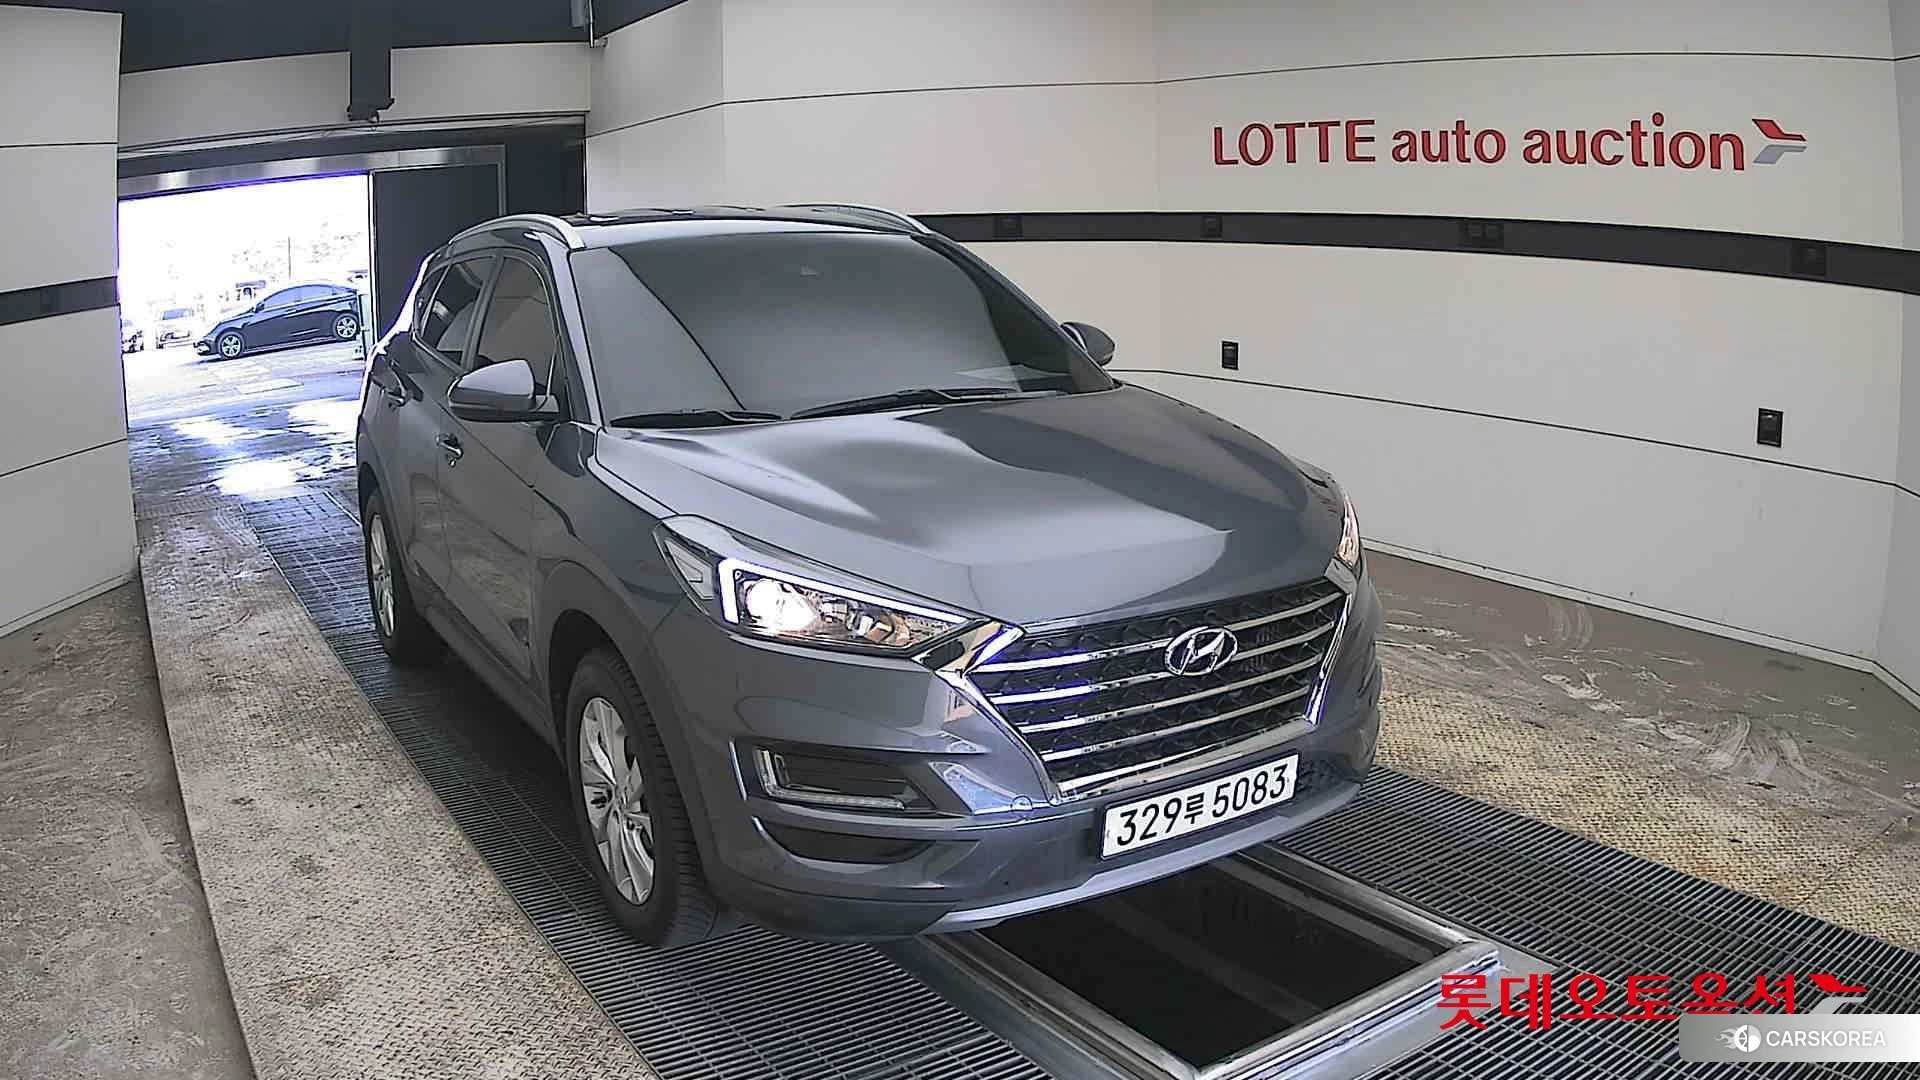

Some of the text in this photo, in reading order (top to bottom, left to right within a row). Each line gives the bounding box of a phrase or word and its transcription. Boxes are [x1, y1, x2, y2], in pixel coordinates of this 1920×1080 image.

[1213, 112, 1745, 171] LOTTE auto auction
